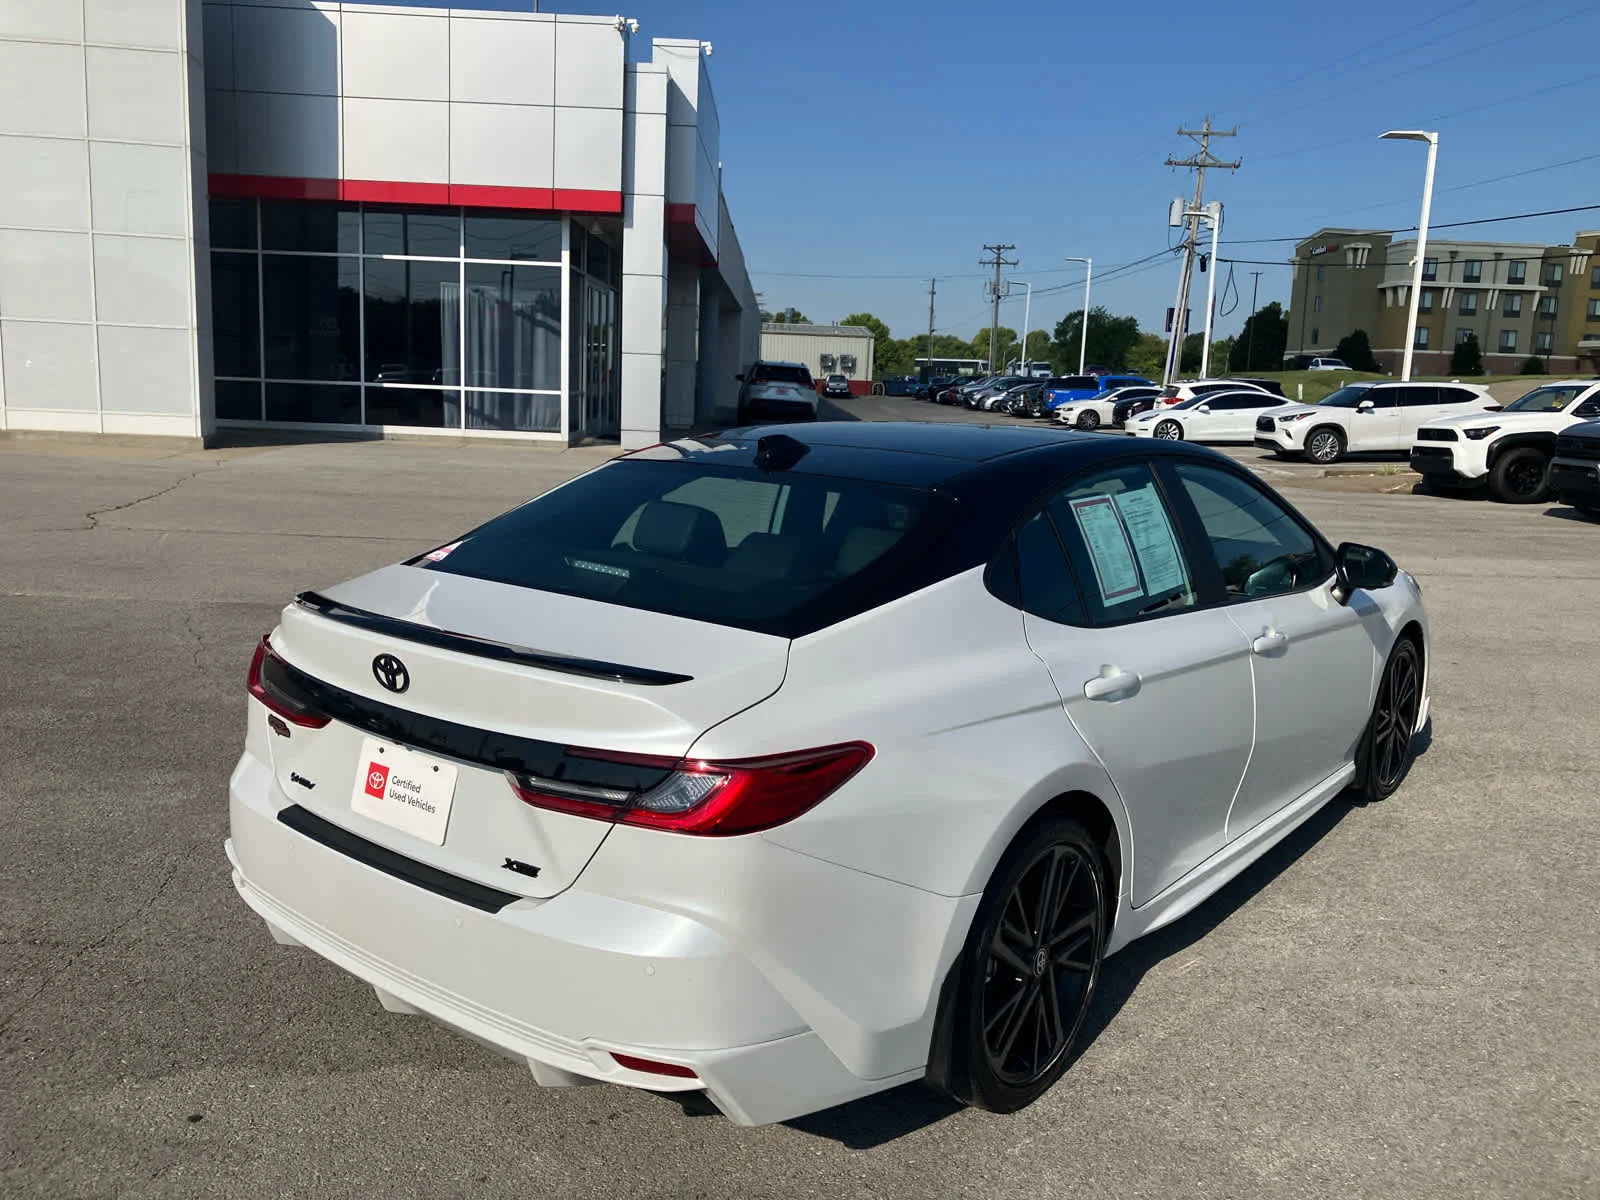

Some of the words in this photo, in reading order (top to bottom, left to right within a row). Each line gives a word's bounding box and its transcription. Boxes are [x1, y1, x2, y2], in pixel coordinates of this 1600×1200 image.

[391, 775, 422, 794] Certified
[389, 789, 407, 803] Used
[407, 794, 436, 814] Vehicles
